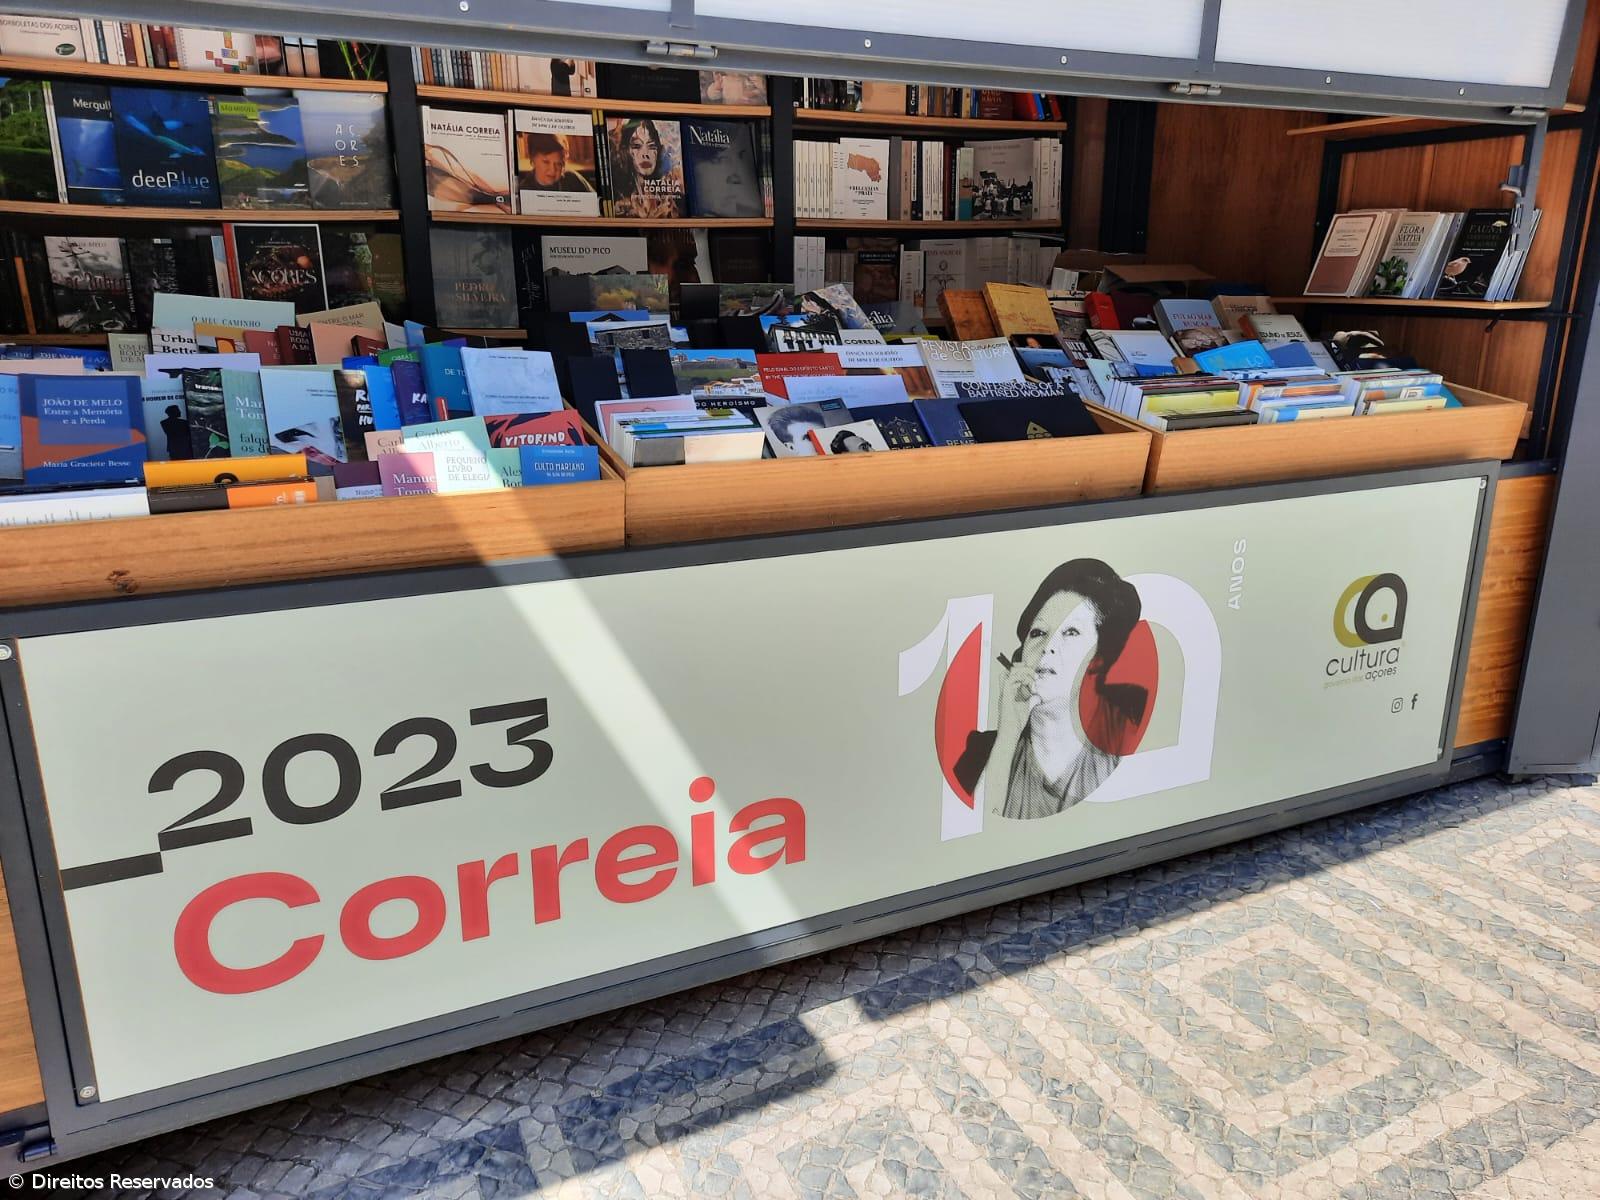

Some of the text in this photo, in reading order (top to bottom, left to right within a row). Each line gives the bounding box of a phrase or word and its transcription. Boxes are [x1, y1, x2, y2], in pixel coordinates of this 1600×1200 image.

[54, 22, 78, 32] AÇORES
[430, 122, 500, 136] NATÁLIA CORREIA
[690, 125, 730, 144] Natália
[644, 177, 680, 186] NATÁLIA
[1400, 226, 1425, 234] FLORA
[550, 246, 576, 254] MUSEU
[592, 247, 611, 255] PICO
[222, 318, 261, 328] CAMINHO
[922, 340, 970, 352] REVISTA
[930, 348, 1013, 361] de CULTURA
[445, 368, 456, 376] DE
[962, 382, 1064, 390] CONFESSIONS OF A
[1021, 390, 1064, 398] WOMAN
[43, 398, 122, 407] JOÃO DE MELO
[44, 408, 70, 416] Entre
[82, 408, 122, 416] Memória
[420, 438, 460, 450] Alberto
[505, 432, 565, 446] VITORINO
[70, 460, 106, 468] Graciete
[446, 456, 488, 465] PEQUENO
[448, 464, 473, 473] LIVRO
[534, 462, 585, 472] CULTO MARIANO
[1226, 538, 1247, 610] ANOS
[1326, 646, 1400, 676] cultura
[1365, 666, 1397, 682] açores
[147, 697, 554, 852] 2023
[174, 776, 806, 995] Correia
